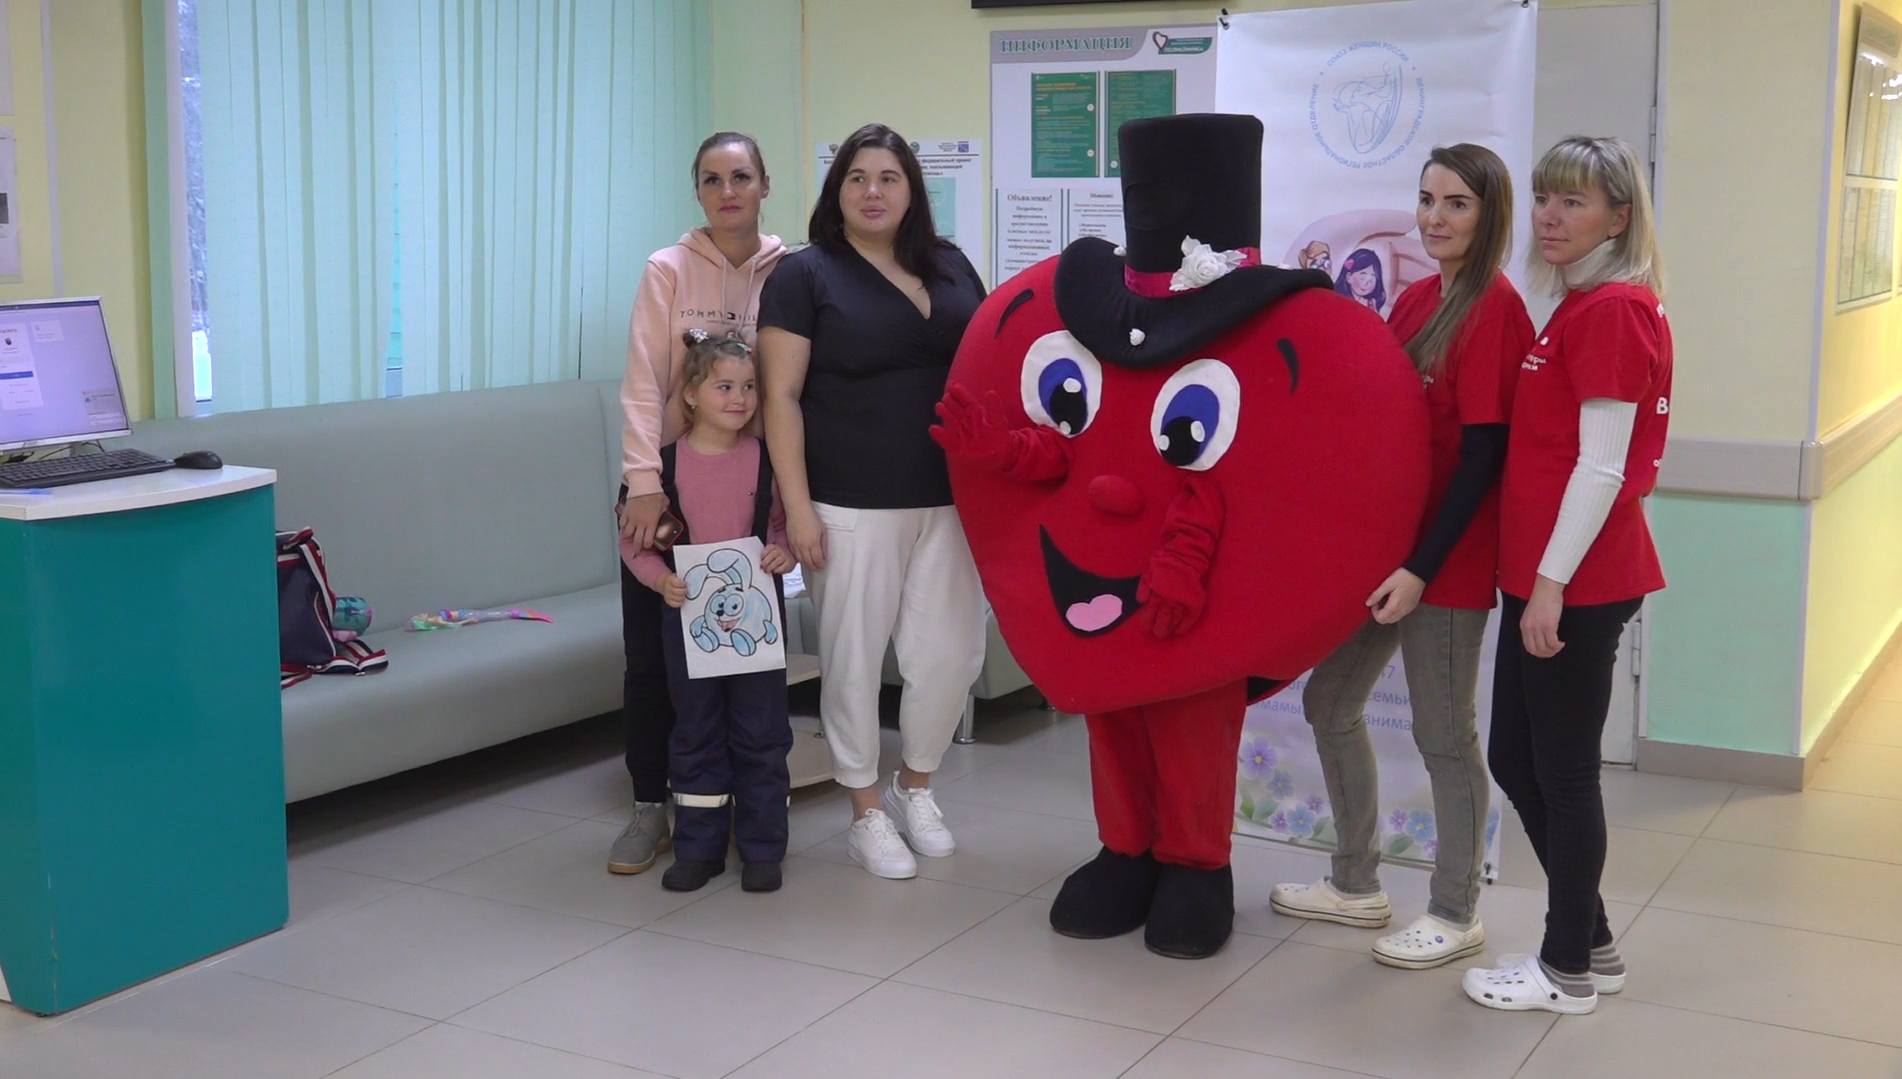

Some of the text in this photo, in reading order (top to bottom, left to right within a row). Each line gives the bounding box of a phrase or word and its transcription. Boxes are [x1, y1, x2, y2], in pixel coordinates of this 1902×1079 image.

[1001, 36, 1131, 53] ИНФОРМАЦИЯ
[1326, 40, 1409, 67] СОЮЗ ЖЕНЩИН РОССИИ
